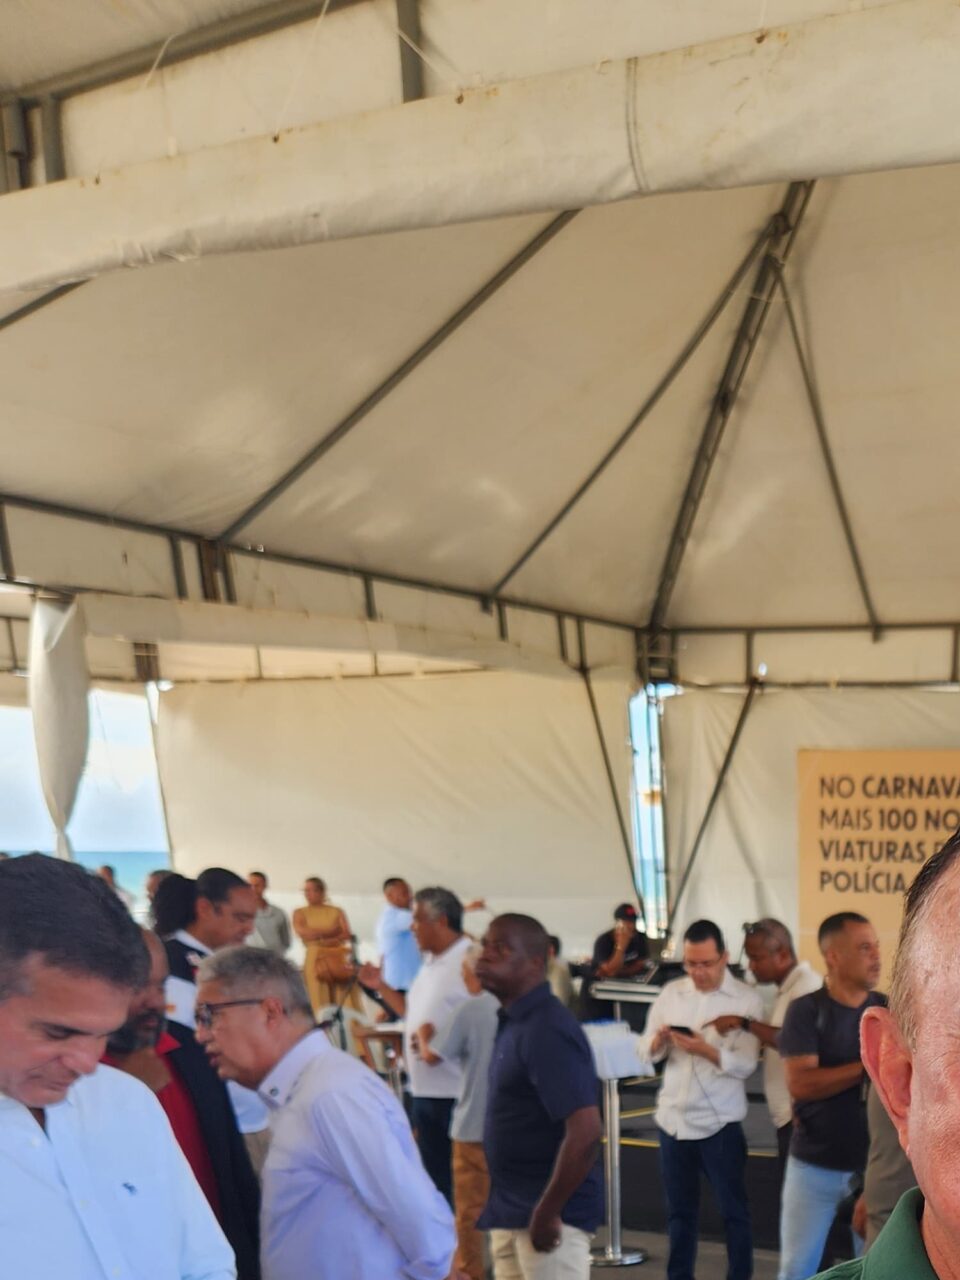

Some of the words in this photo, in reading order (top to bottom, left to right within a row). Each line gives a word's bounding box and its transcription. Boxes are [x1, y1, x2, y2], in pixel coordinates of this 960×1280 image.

[819, 776, 855, 799] NO
[820, 808, 872, 831] MAIS
[879, 808, 917, 832] 100
[819, 840, 926, 863] VIATURAS
[819, 866, 906, 893] POLÍCIA
